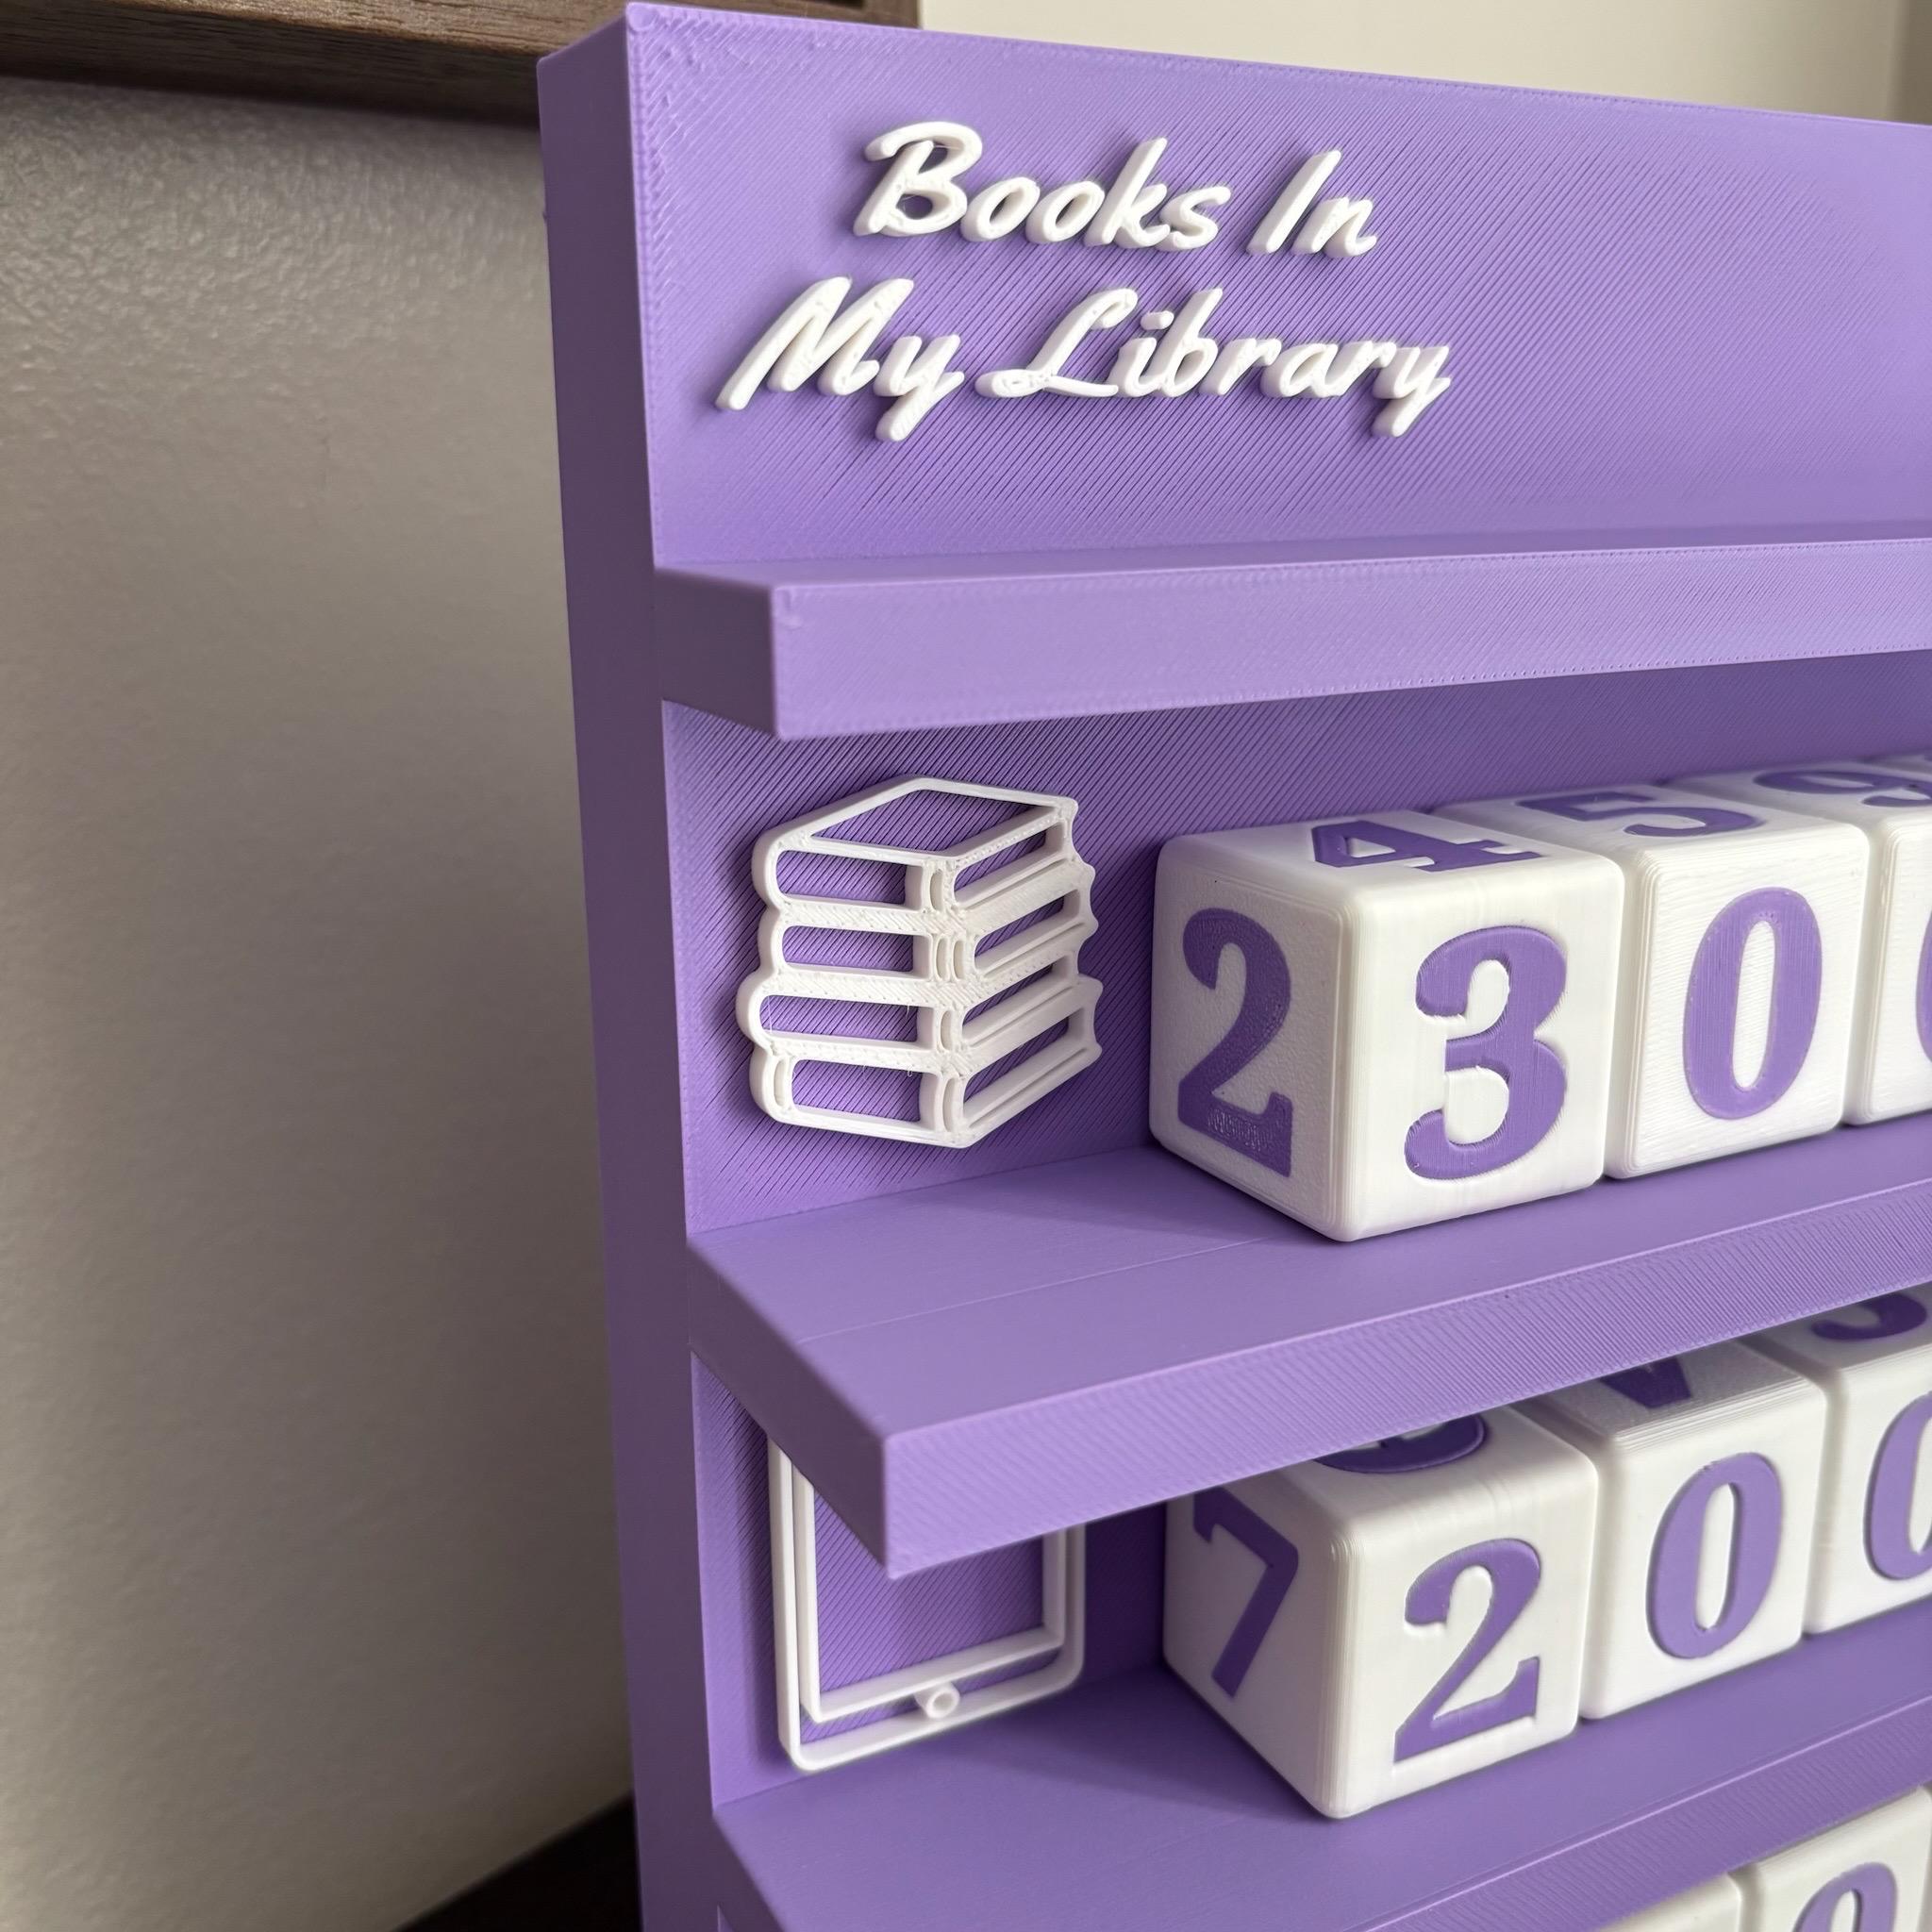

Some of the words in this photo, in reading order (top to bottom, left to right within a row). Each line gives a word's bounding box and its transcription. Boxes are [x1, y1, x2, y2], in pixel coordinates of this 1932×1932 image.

[853, 121, 1231, 252] Books
[1246, 149, 1377, 258] In
[715, 275, 964, 442] My
[975, 287, 1452, 438] Library
[1314, 820, 1541, 873] 4
[1514, 791, 1765, 838] 5
[1177, 907, 1293, 1178] 2
[1404, 924, 1567, 1180] 3
[1682, 886, 1823, 1121] 0
[1192, 1486, 1299, 1699] 7
[1393, 1537, 1541, 1763] 2
[1646, 1451, 1784, 1659] 0
